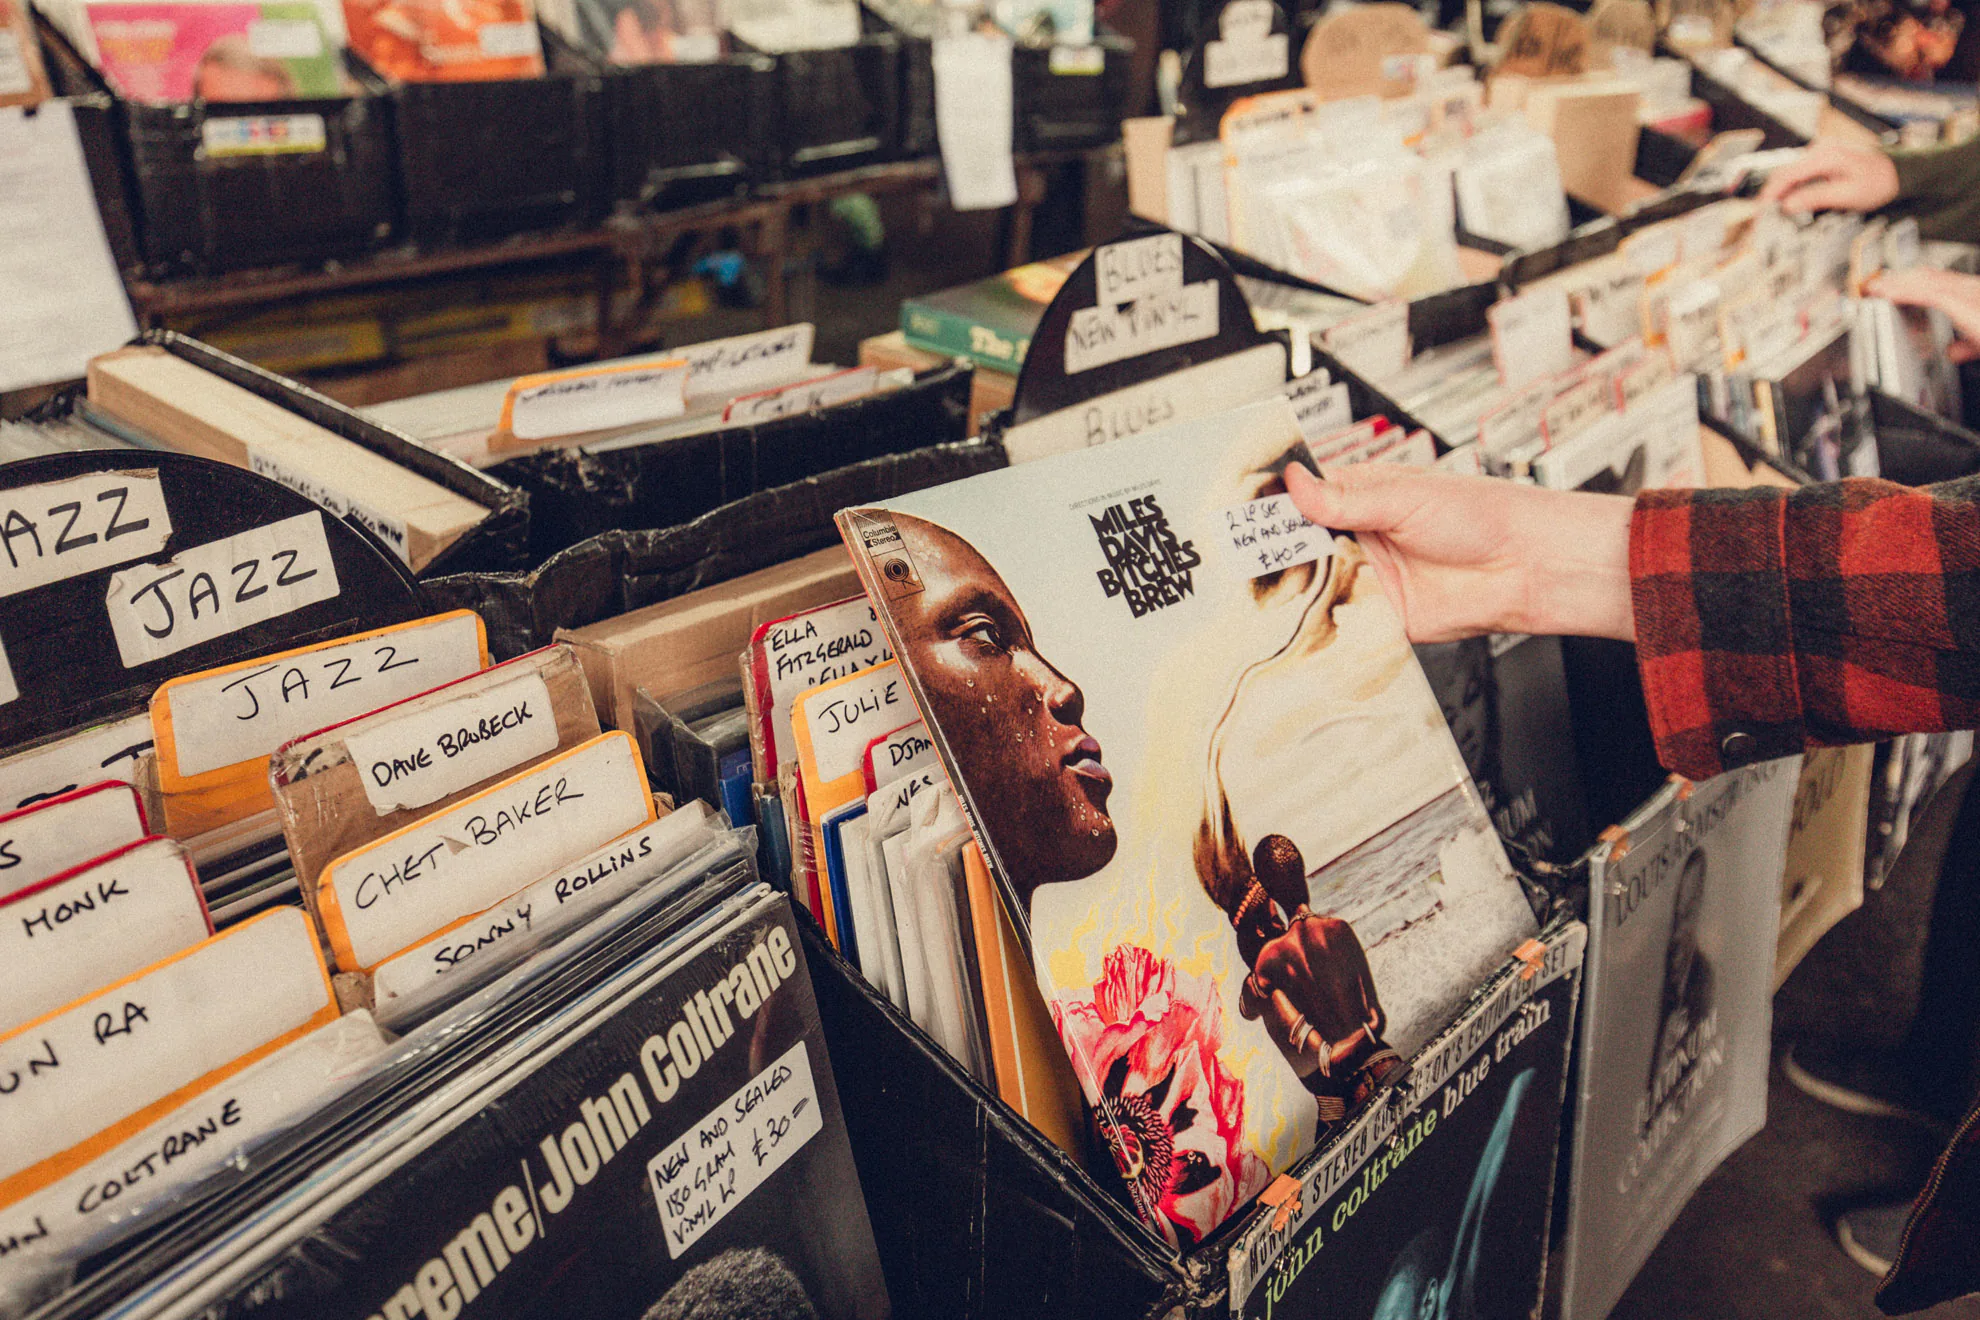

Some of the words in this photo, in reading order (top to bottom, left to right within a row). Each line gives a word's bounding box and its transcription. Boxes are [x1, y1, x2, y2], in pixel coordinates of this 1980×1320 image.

[1103, 246, 1181, 293] BLUES
[1085, 402, 1175, 447] BLUES
[0, 487, 149, 567] AZZ
[863, 524, 896, 539] Columbia
[871, 534, 896, 547] Stereo
[1087, 494, 1163, 539] MILES
[1099, 518, 1177, 568] DAVIS
[1226, 511, 1241, 530] 2
[1233, 528, 1257, 549] NEW
[131, 550, 317, 638] JAZZ
[1096, 540, 1201, 598] BITCHES
[1123, 569, 1194, 619] BREW
[772, 621, 817, 652] ELLA
[776, 629, 873, 680] FITZGERALD
[222, 647, 419, 720] JAZZ
[372, 748, 433, 787] DAVE
[437, 702, 532, 757] BRUBECK
[889, 737, 933, 766] DJAN
[355, 843, 443, 909] CHET
[465, 778, 584, 845] BAKER
[22, 880, 129, 937] MONK
[436, 904, 531, 974] SONNY
[640, 925, 796, 1103] Coltrane
[0, 1040, 60, 1094] UN
[94, 1002, 148, 1045] RA
[1313, 1126, 1368, 1205] STEREO
[1542, 942, 1569, 979] SET
[655, 1143, 690, 1189] NEW
[700, 1117, 729, 1149] AND
[735, 1065, 792, 1123] SEALED
[77, 1099, 242, 1214] COLTRANE
[1264, 1227, 1324, 1320] john
[1332, 1109, 1438, 1232] coltrane
[1442, 1053, 1491, 1119] blue
[1495, 999, 1551, 1063] train
[666, 1186, 691, 1218] 180
[719, 1168, 735, 1203] LP
